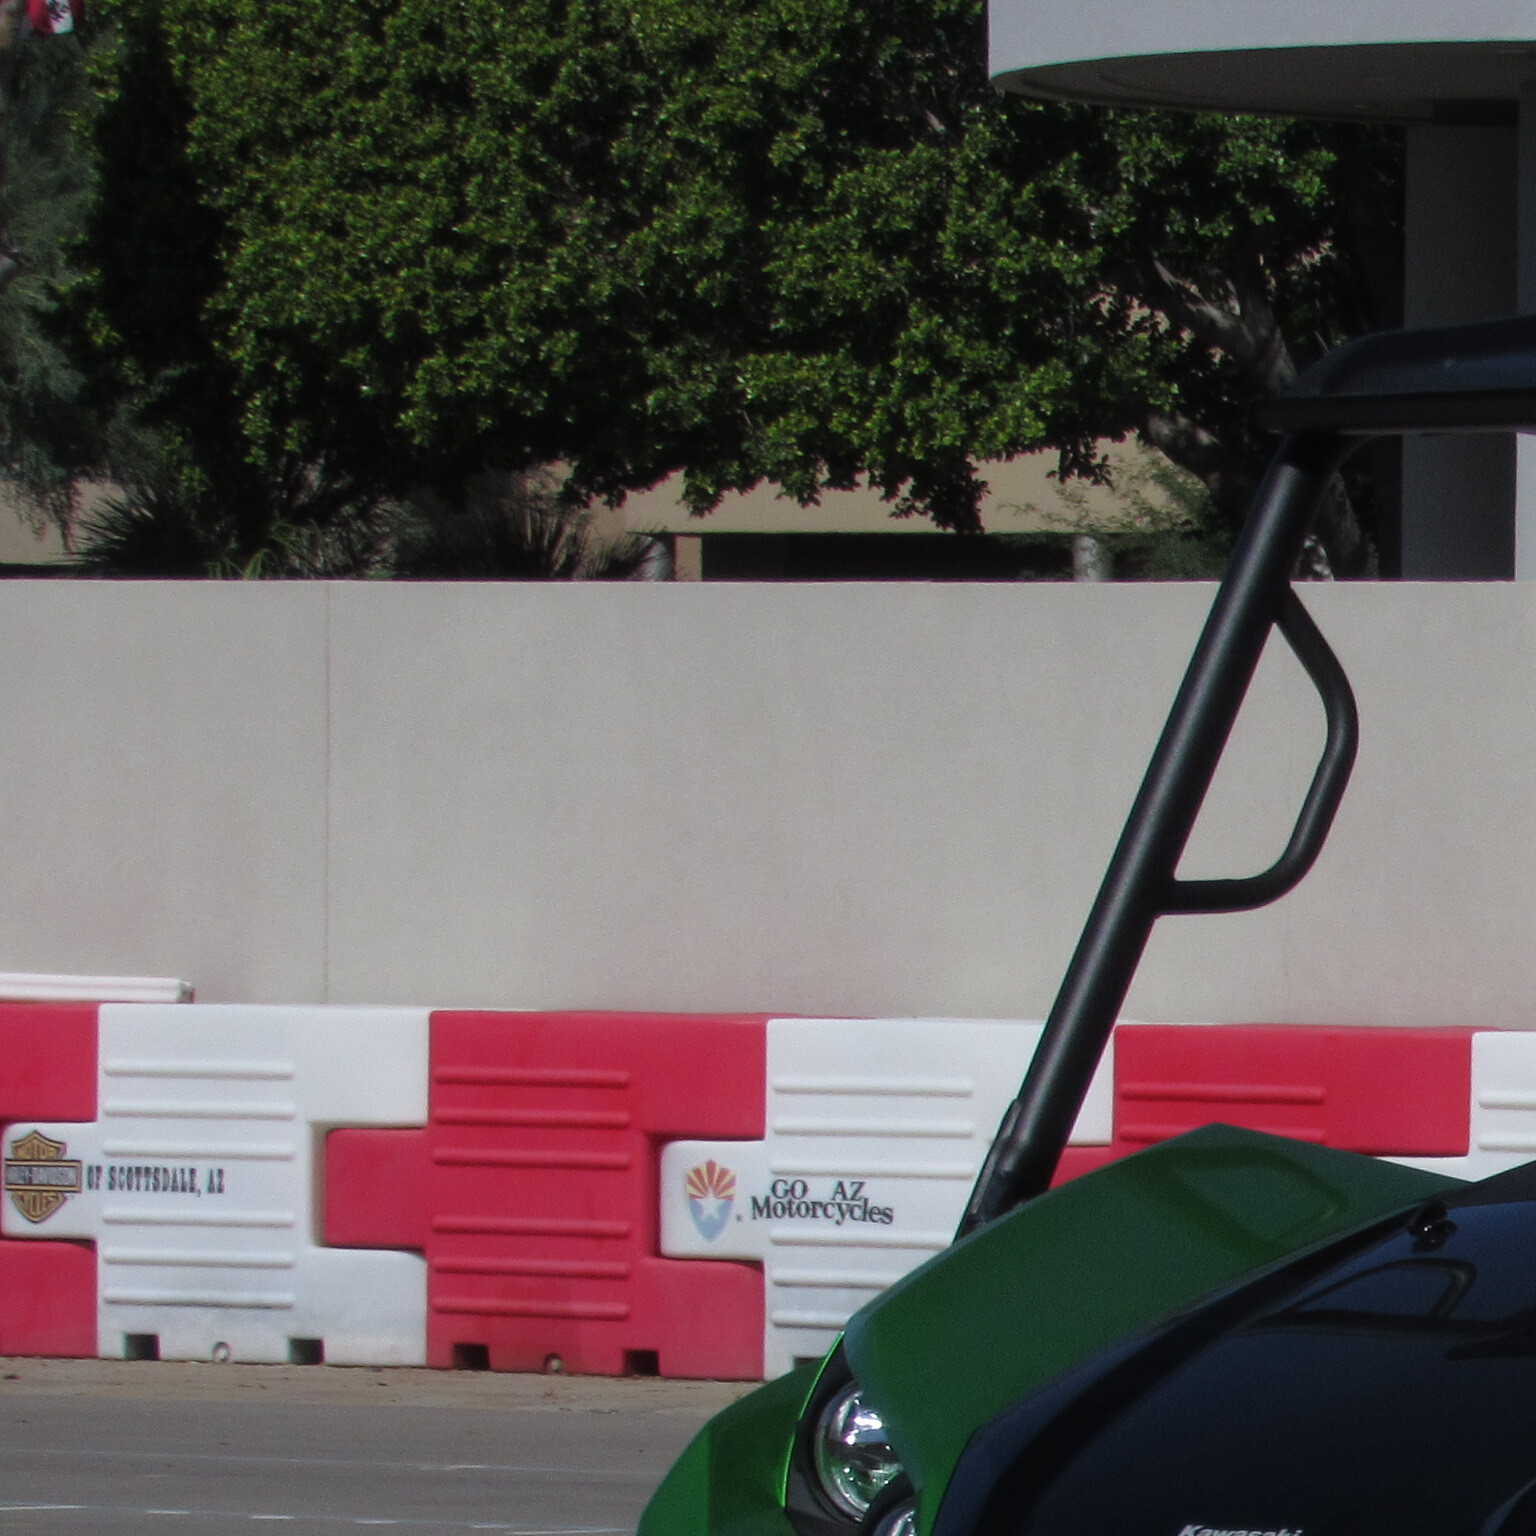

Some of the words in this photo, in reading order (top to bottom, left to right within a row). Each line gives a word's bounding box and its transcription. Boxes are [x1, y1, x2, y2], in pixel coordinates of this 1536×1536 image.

[207, 1169, 224, 1193] AZ
[772, 1179, 808, 1199] GO
[832, 1181, 866, 1202] AZ
[752, 1196, 893, 1225] Motorcycles
